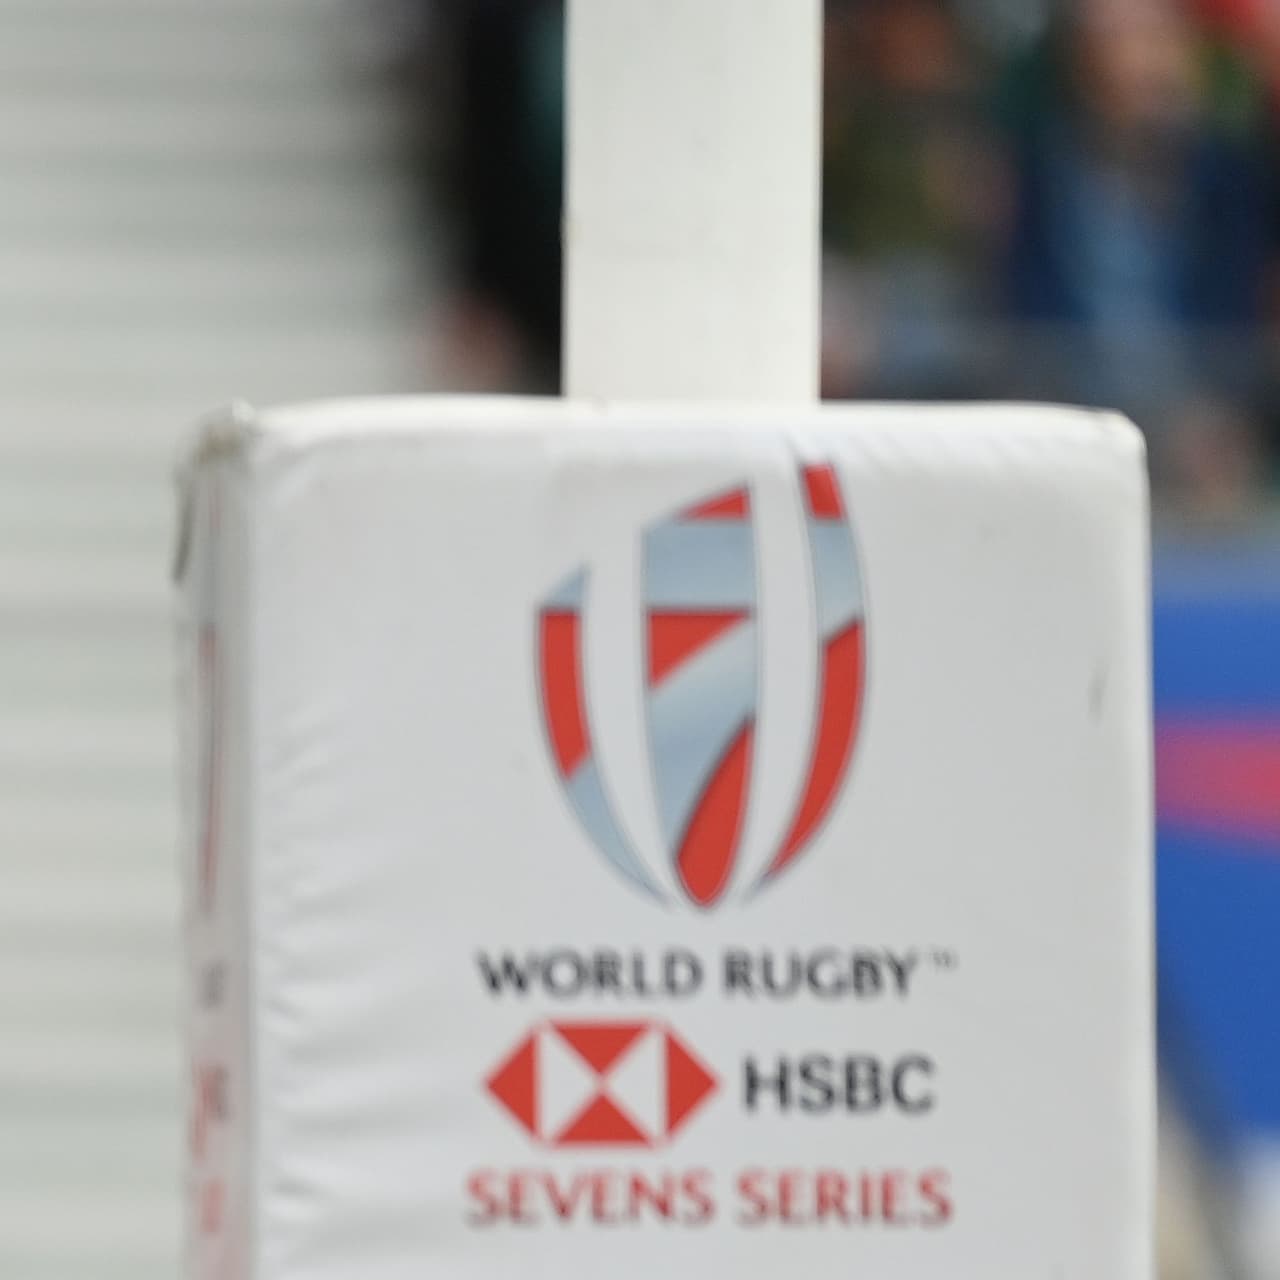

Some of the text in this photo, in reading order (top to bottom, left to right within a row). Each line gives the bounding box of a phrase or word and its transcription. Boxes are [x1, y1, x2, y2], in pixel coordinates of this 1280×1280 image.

[474, 948, 704, 997] WORLD
[742, 1052, 937, 1116] HSBC
[466, 1166, 956, 1228] SEVENS SERIES
